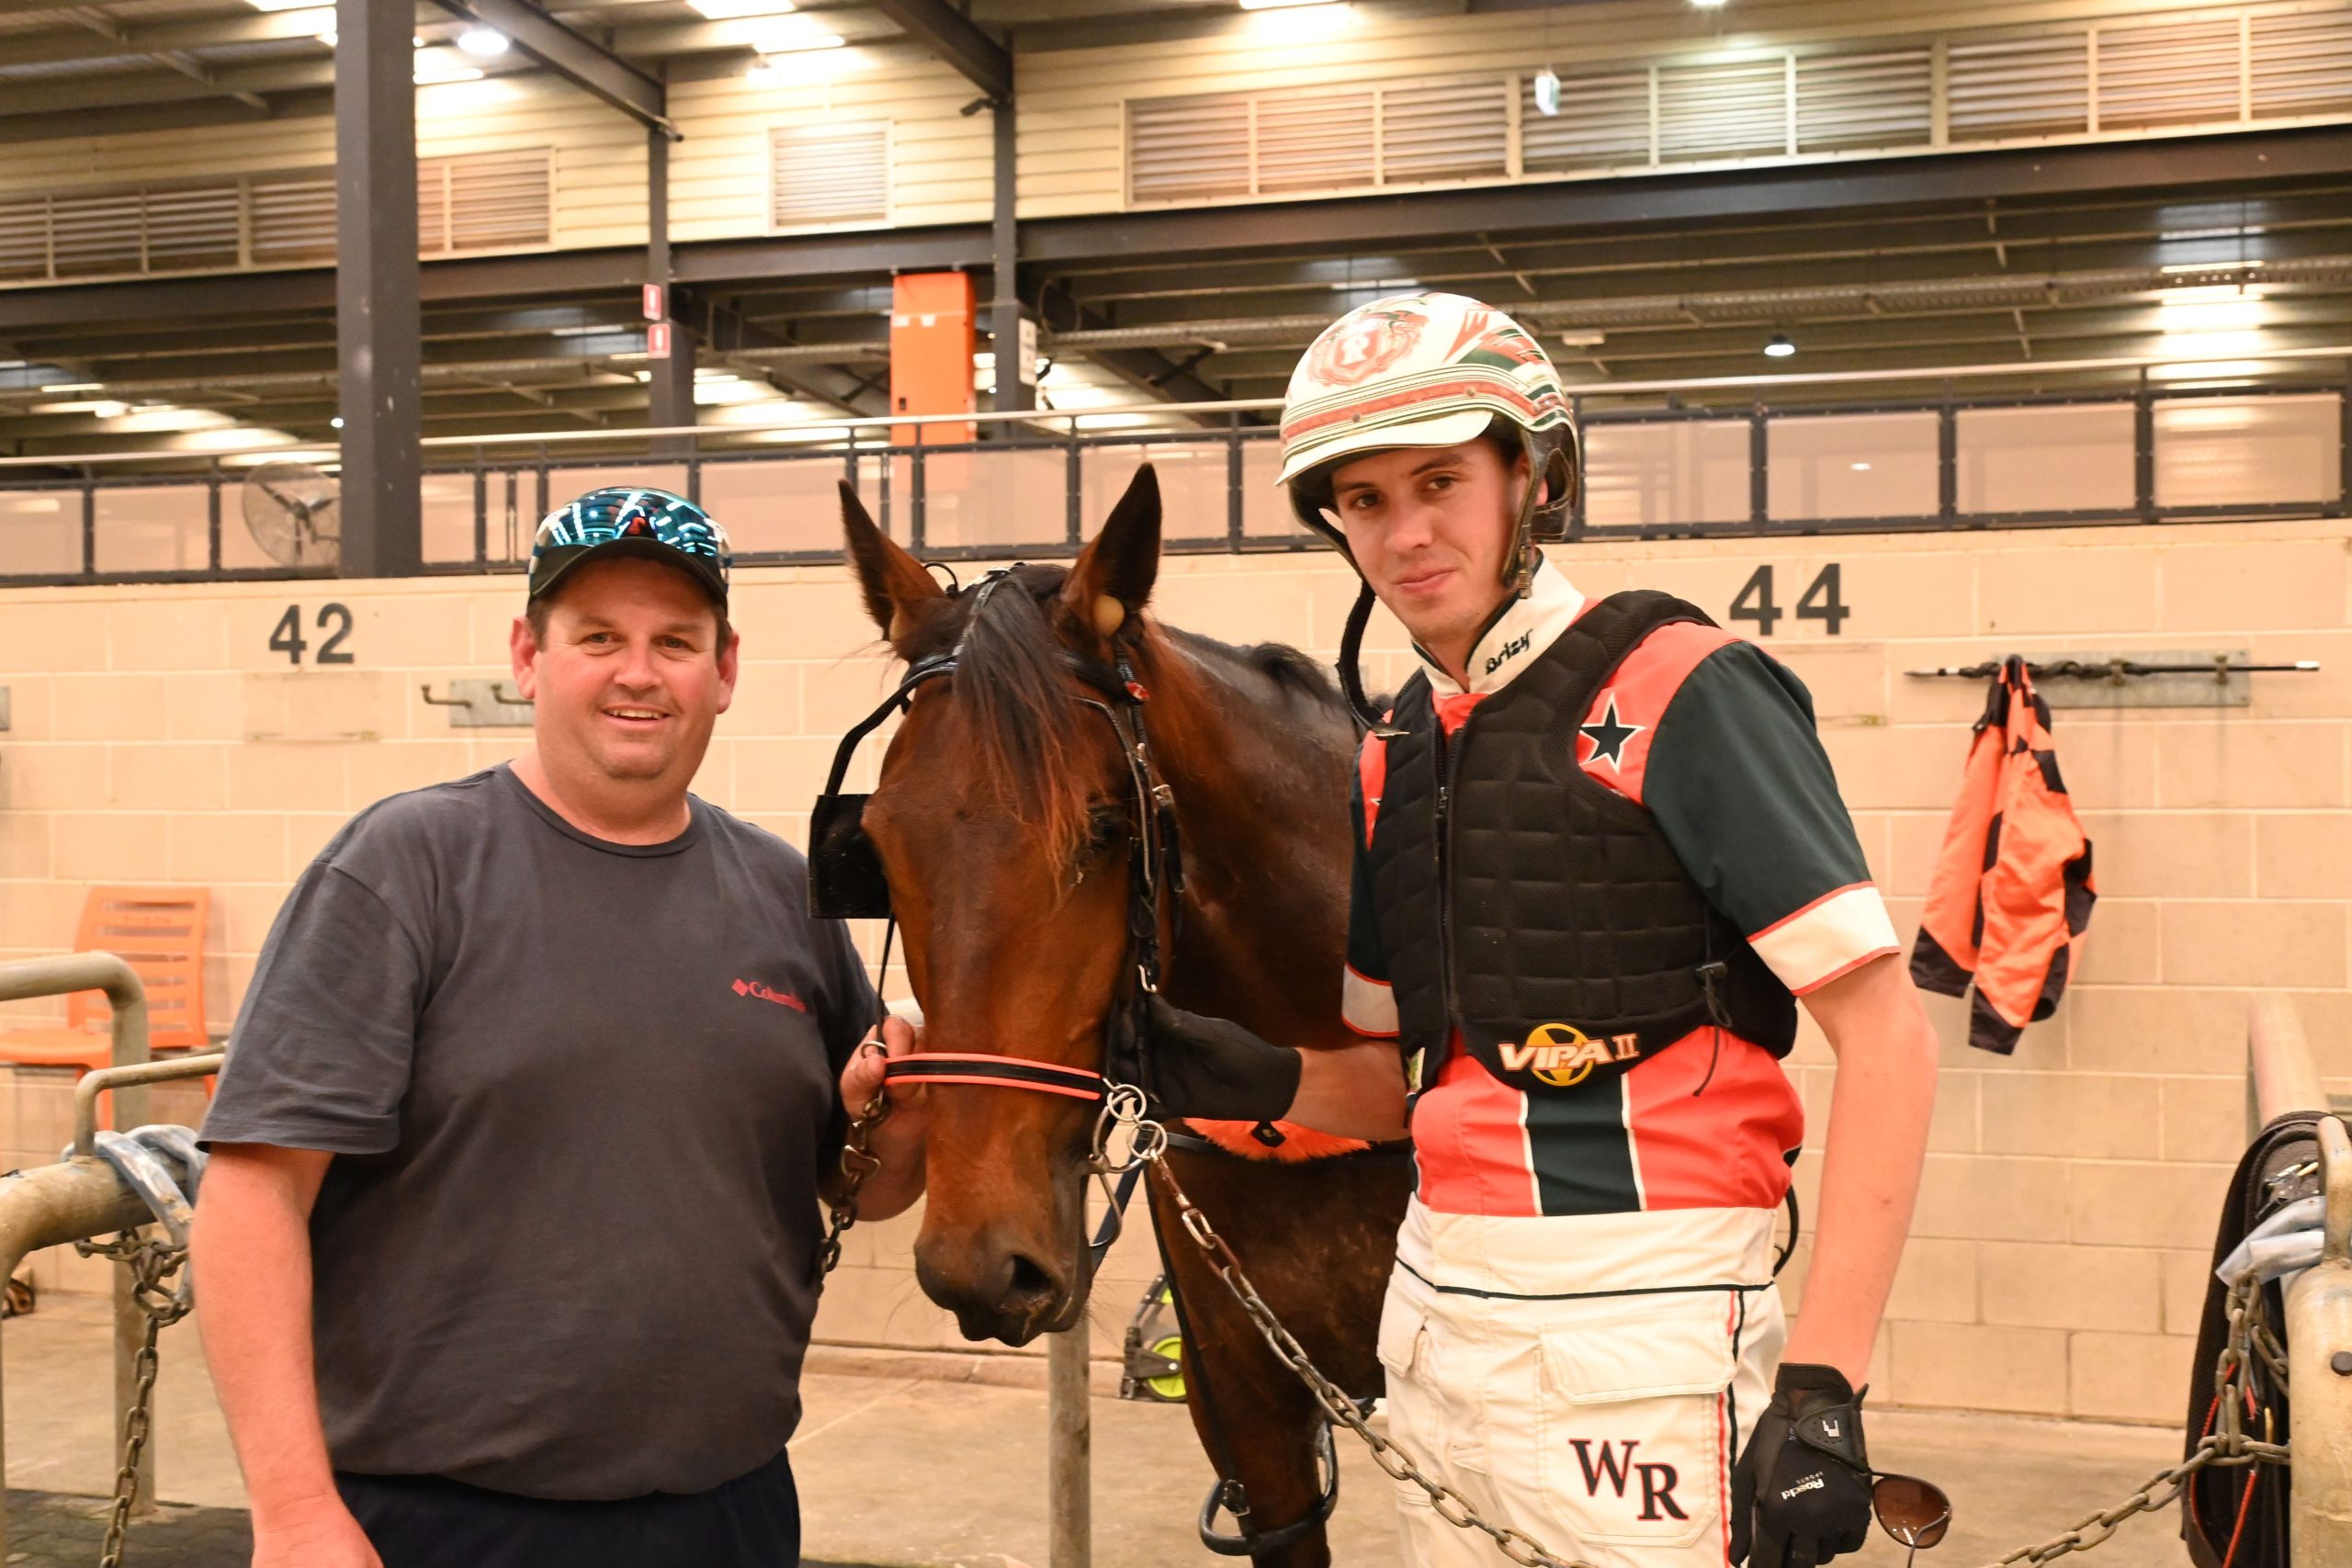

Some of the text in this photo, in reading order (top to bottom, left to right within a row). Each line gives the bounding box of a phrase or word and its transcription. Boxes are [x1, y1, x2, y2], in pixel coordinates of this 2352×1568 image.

[1729, 562, 1850, 637] 44
[269, 603, 355, 664] 42
[1498, 1038, 1614, 1071] VIPA
